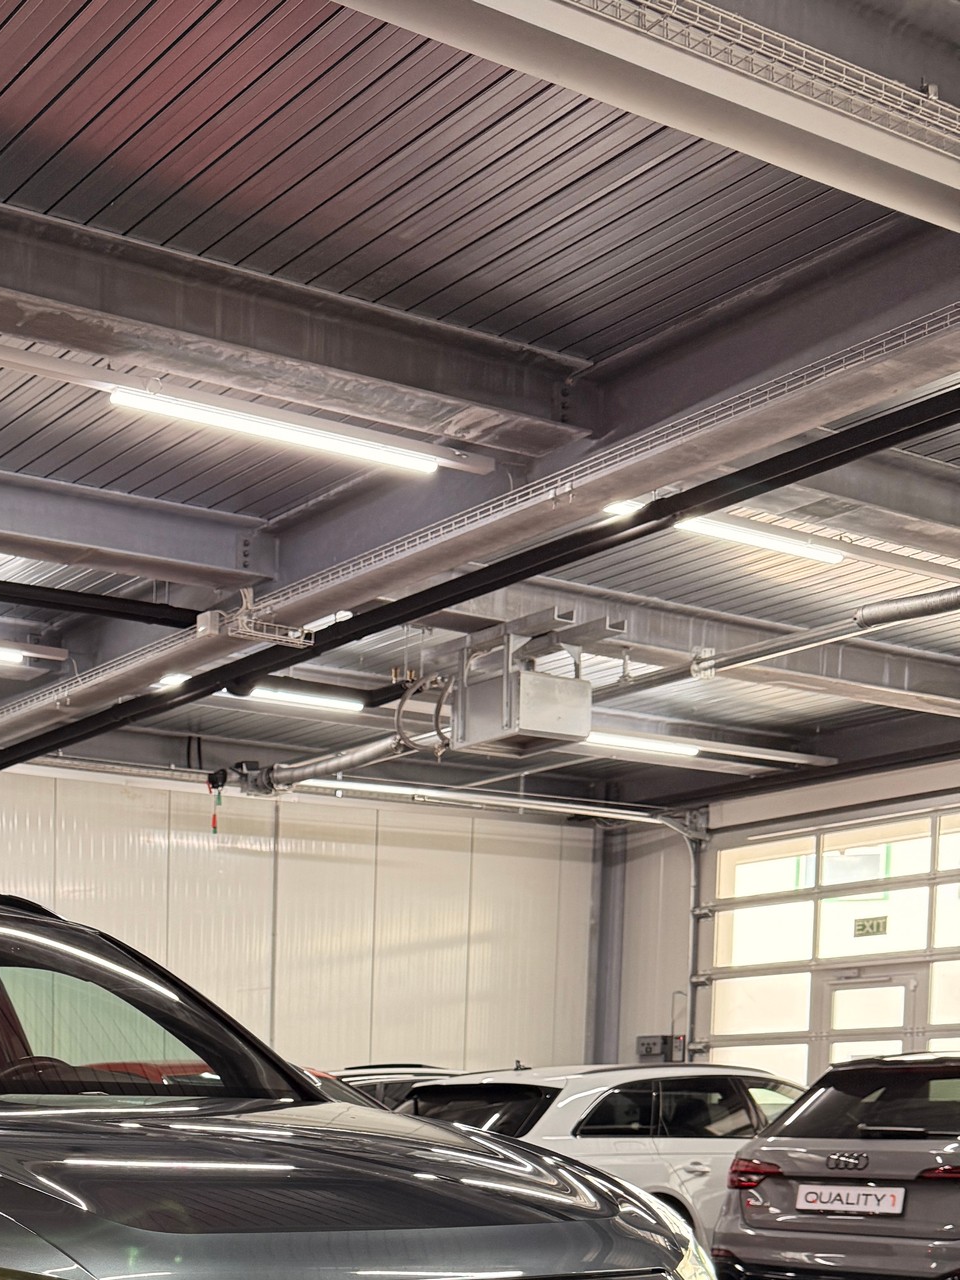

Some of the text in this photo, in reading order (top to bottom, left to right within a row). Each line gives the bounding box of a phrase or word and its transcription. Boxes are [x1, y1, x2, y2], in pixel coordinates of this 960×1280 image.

[856, 920, 886, 934] EXIT
[804, 1191, 897, 1207] QUALITY 1
